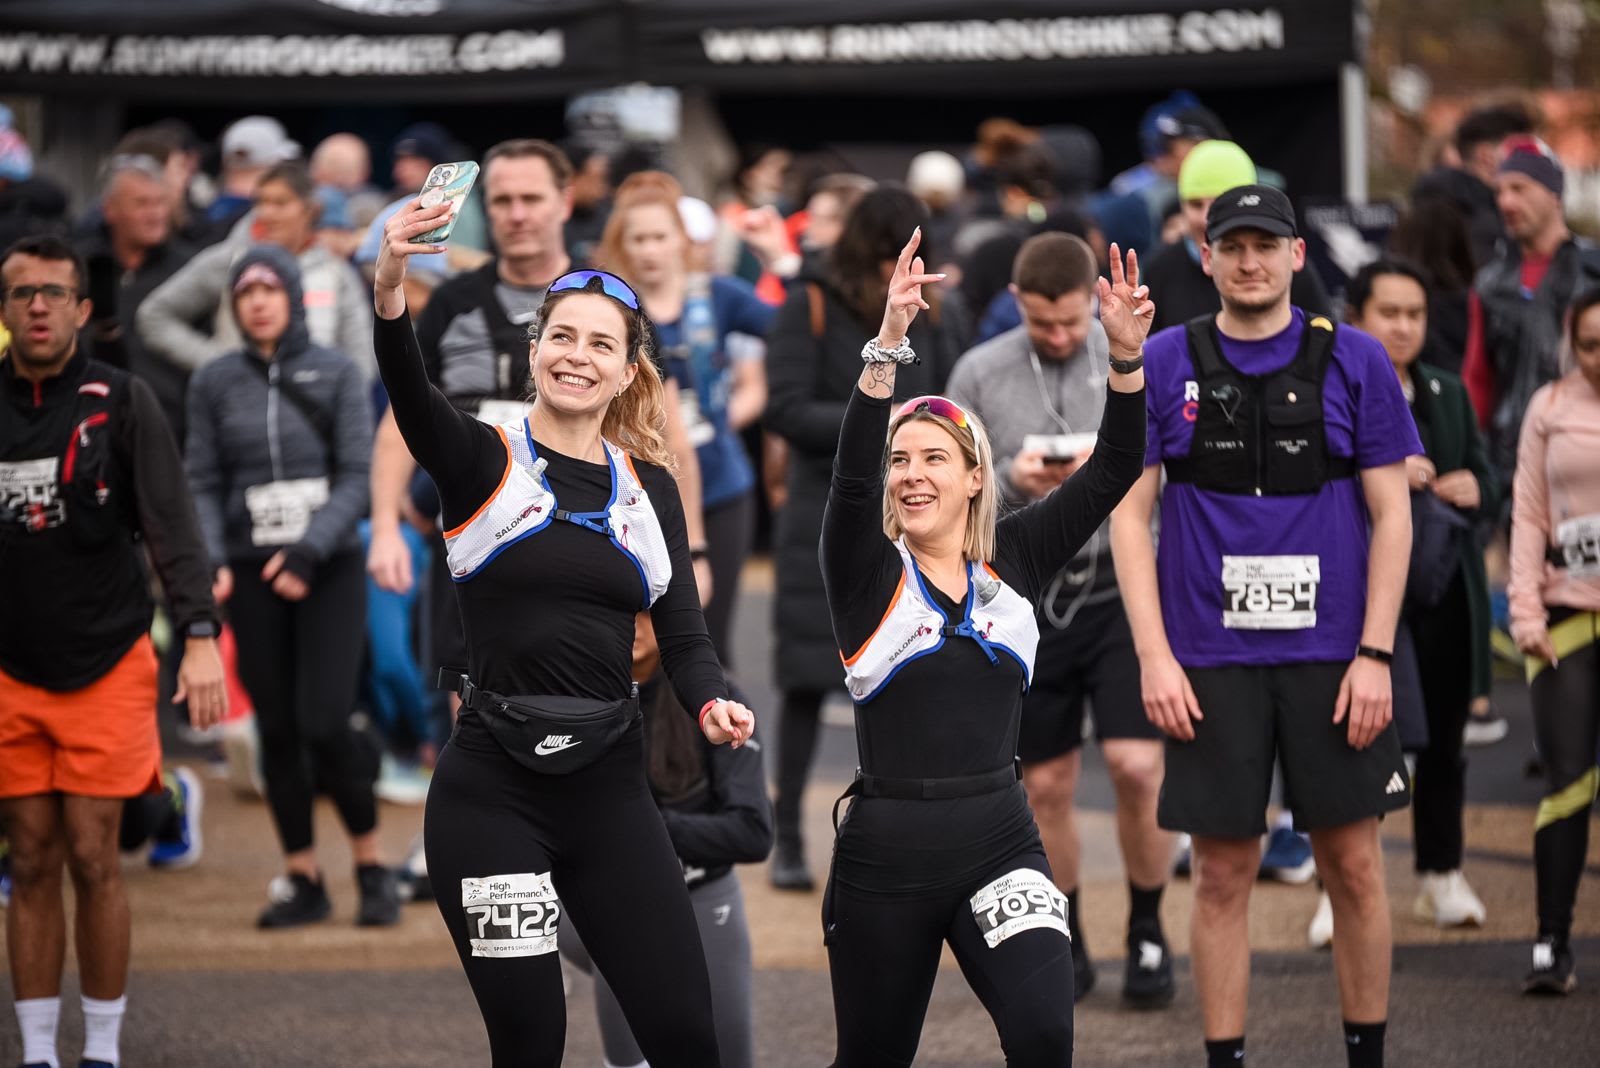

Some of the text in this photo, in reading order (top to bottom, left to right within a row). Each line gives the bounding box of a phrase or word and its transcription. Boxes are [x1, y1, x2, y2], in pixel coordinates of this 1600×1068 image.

[495, 504, 535, 540] SALOM
[1223, 582, 1317, 613] 7854
[541, 734, 573, 747] NIKE
[489, 881, 511, 892] High
[993, 878, 1013, 891] High
[466, 901, 560, 938] 7422
